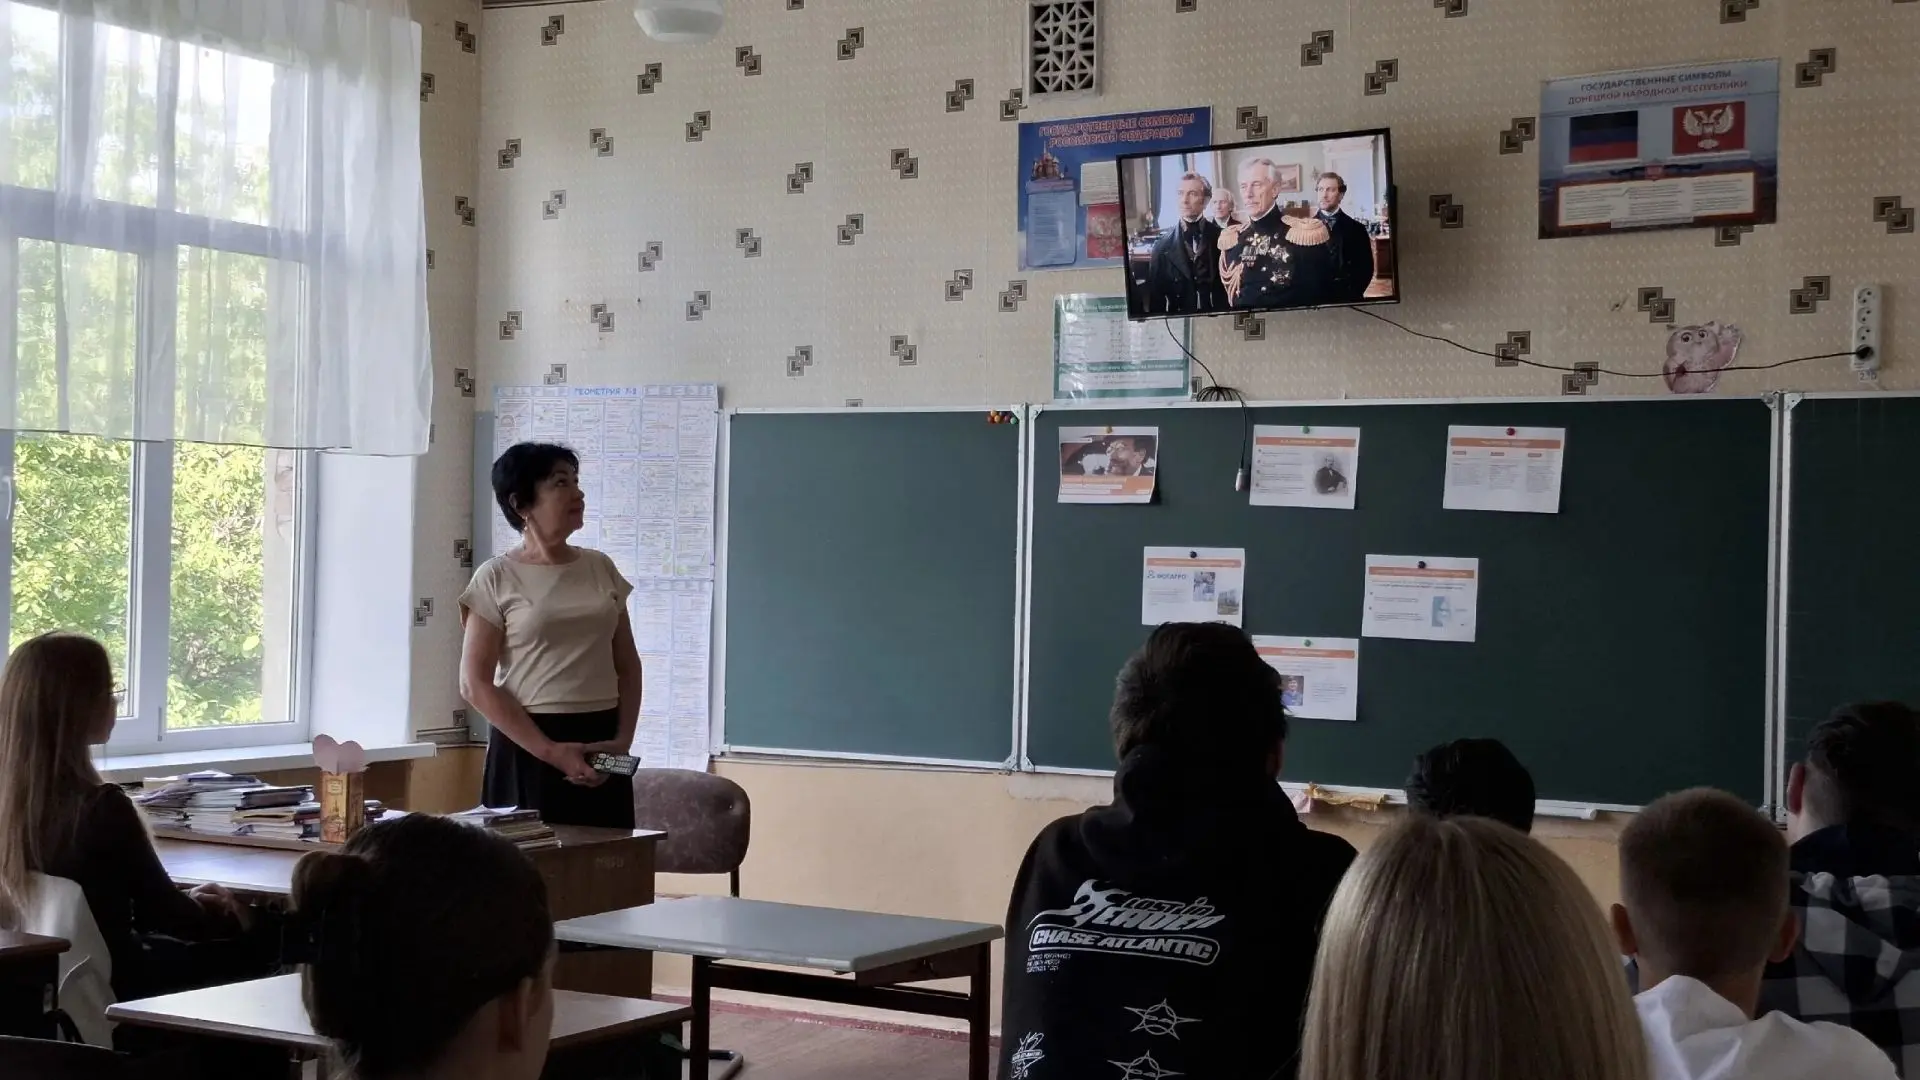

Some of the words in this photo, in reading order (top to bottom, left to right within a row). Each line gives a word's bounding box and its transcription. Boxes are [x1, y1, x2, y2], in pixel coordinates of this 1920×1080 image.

[1581, 76, 1676, 91] ГОСУДАРСТВЕННЫЕ
[1678, 70, 1732, 82] СИМВОЛЫ
[1568, 91, 1621, 105] ДОНЕЦКОЙ
[1623, 87, 1679, 99] НАРОДНОЙ
[1681, 81, 1748, 94] РЕСПУБЛИКИ
[1038, 117, 1137, 137] ГОСУДАРСТВЕННЫЕ
[1138, 113, 1195, 127] СИМВОЛЫ
[1049, 130, 1118, 148] РОССИЙСКОЙ
[1119, 126, 1184, 142] ФЕДЕРАЦИИ
[574, 387, 621, 396] ГЕОМЕТРИЯ
[1121, 897, 1186, 914] LOST
[1032, 929, 1100, 945] CHASE
[1097, 936, 1213, 959] ATLANTIC
